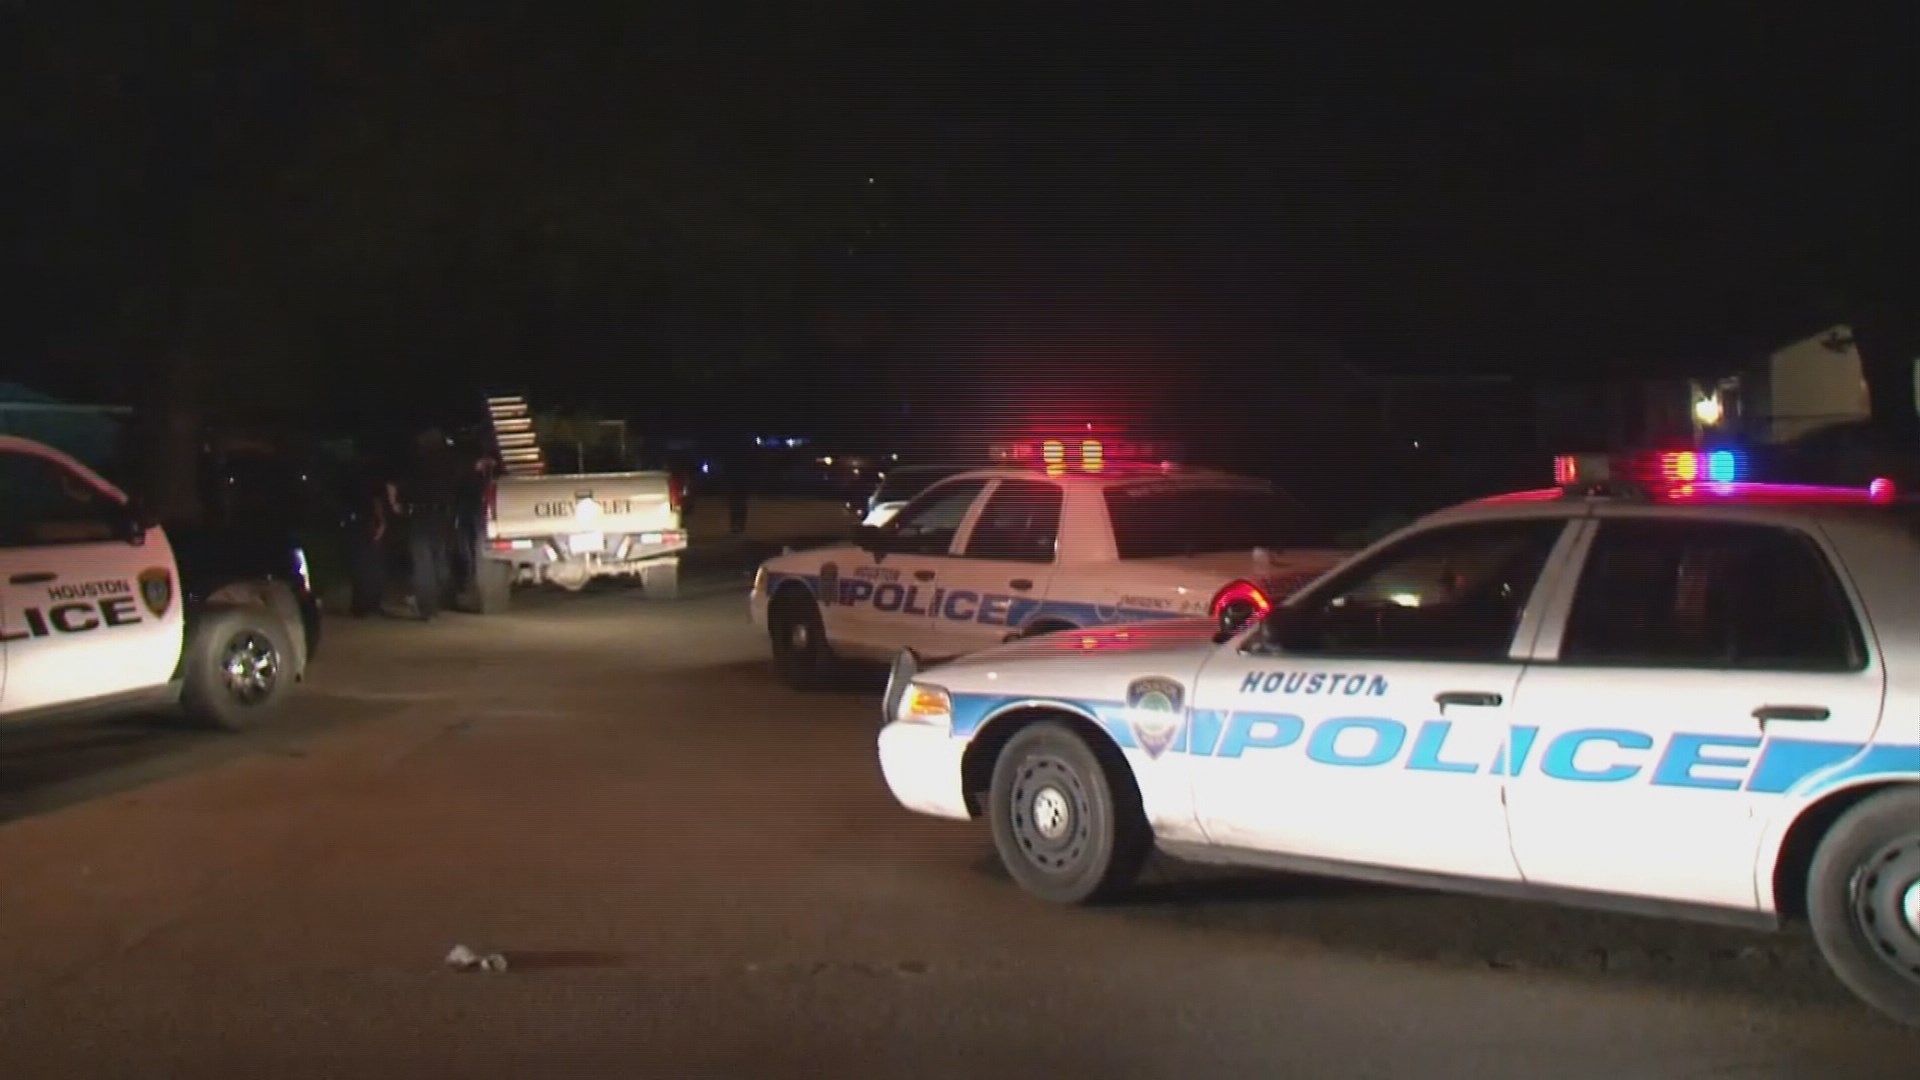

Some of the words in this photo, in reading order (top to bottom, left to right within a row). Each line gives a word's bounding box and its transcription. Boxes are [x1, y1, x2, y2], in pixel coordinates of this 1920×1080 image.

[535, 500, 632, 518] CHEVLET
[49, 578, 131, 600] HOUSTON
[846, 578, 1010, 626] POLICE
[1239, 671, 1388, 697] HOUSTON
[1216, 709, 1763, 792] POLICE
